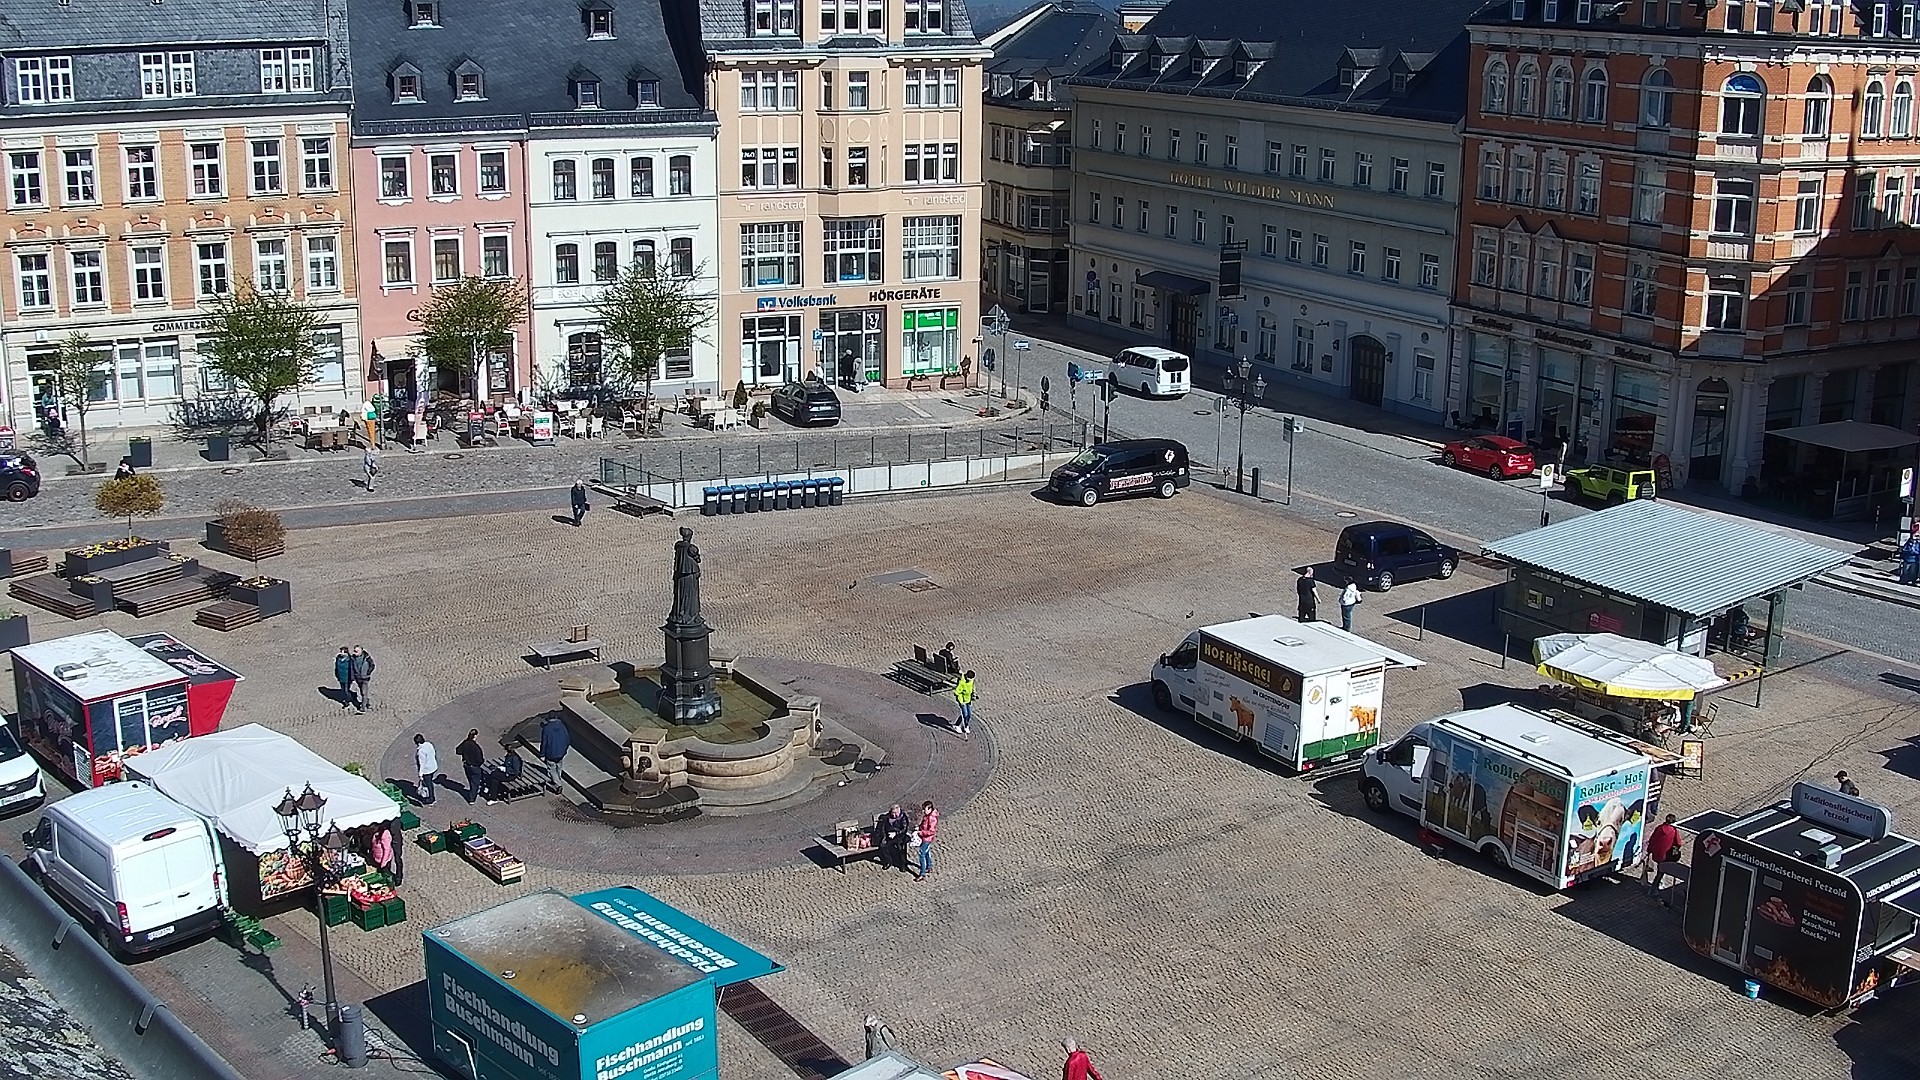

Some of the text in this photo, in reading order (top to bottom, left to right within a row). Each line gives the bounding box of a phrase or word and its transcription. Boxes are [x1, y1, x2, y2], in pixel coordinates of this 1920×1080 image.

[760, 199, 805, 212] randstad
[922, 193, 965, 206] randstad
[1170, 171, 1334, 208] HOTEL WILDER MANN
[779, 293, 837, 309] Volksbank
[869, 287, 941, 302] HÖRGERÄTE
[1483, 756, 1530, 783] Roßler
[1537, 780, 1563, 799] Hof
[1580, 780, 1616, 799] Roßler
[1624, 770, 1644, 785] Hof
[1803, 792, 1873, 822] Traditionsfleischerei
[1823, 808, 1850, 824] Petzold
[1729, 847, 1813, 886] Traditionsfleischerei
[1814, 879, 1848, 899] Petzold
[1801, 918, 1841, 939] Rauchwurst
[1803, 909, 1836, 928] Bratwurst
[590, 902, 721, 974] Fischhandlung
[633, 911, 738, 969] Buschmann
[443, 972, 559, 1067] Fischhandlung
[444, 992, 535, 1068] Buschmann
[596, 1017, 704, 1072] Fischhandlung
[596, 1040, 682, 1080] Buschmann
